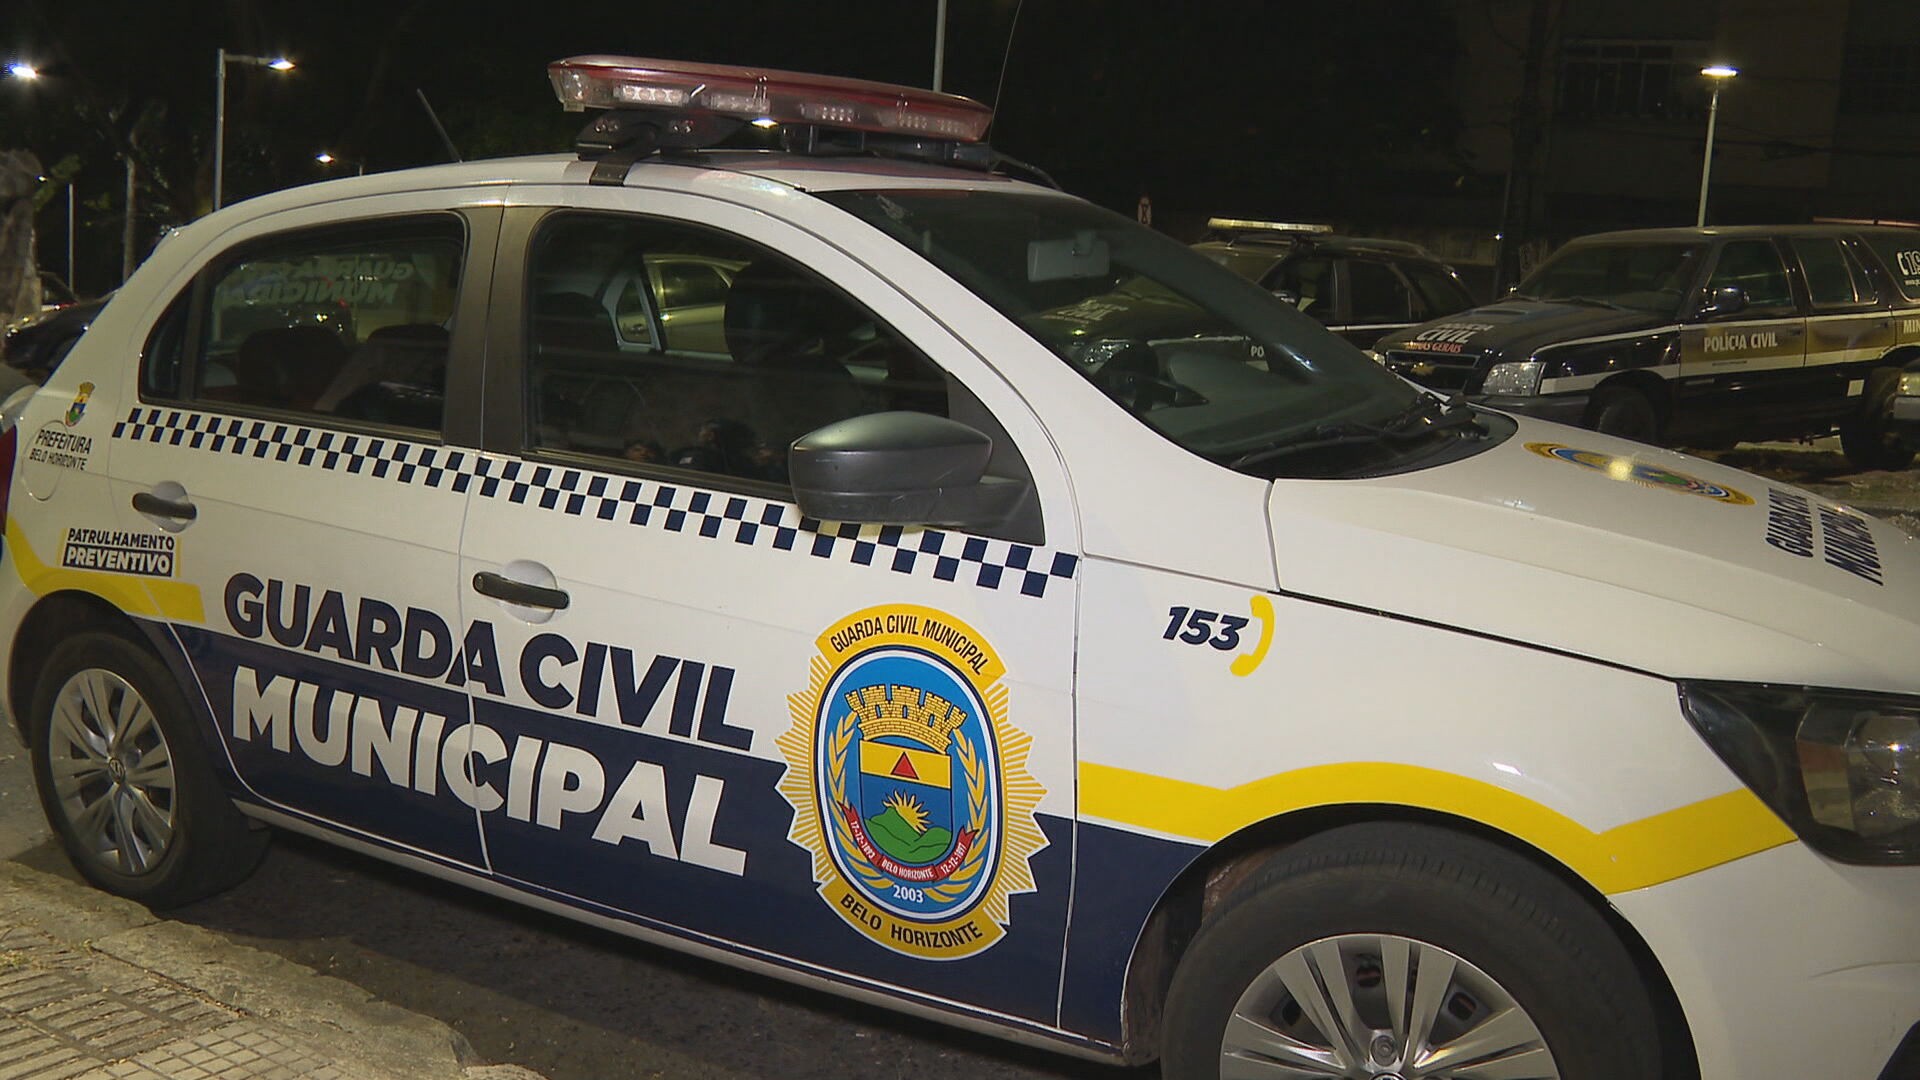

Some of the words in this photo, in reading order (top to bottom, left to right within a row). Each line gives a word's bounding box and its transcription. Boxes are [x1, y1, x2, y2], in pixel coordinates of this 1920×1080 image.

[1751, 332, 1778, 348] CIVIL
[36, 429, 92, 455] PREFEITURA
[29, 447, 48, 464] BELO
[48, 453, 88, 471] HORIZONTE
[67, 527, 175, 551] PATRULHAMENTO
[65, 546, 171, 574] PREVENTIVO
[1163, 606, 1249, 651] 153
[829, 616, 884, 653] GUARDA
[886, 614, 920, 637] CIVIL
[922, 618, 991, 676] MUNICIPAL
[224, 572, 505, 698] GUARDA
[519, 633, 754, 751] CIVIL
[232, 665, 747, 876] MUNICIPAL
[881, 859, 898, 874] BELO
[898, 867, 934, 880] HORIZONTE
[893, 884, 924, 903] 2003
[840, 893, 882, 930] BELO
[890, 920, 983, 949] HORIZONTE
